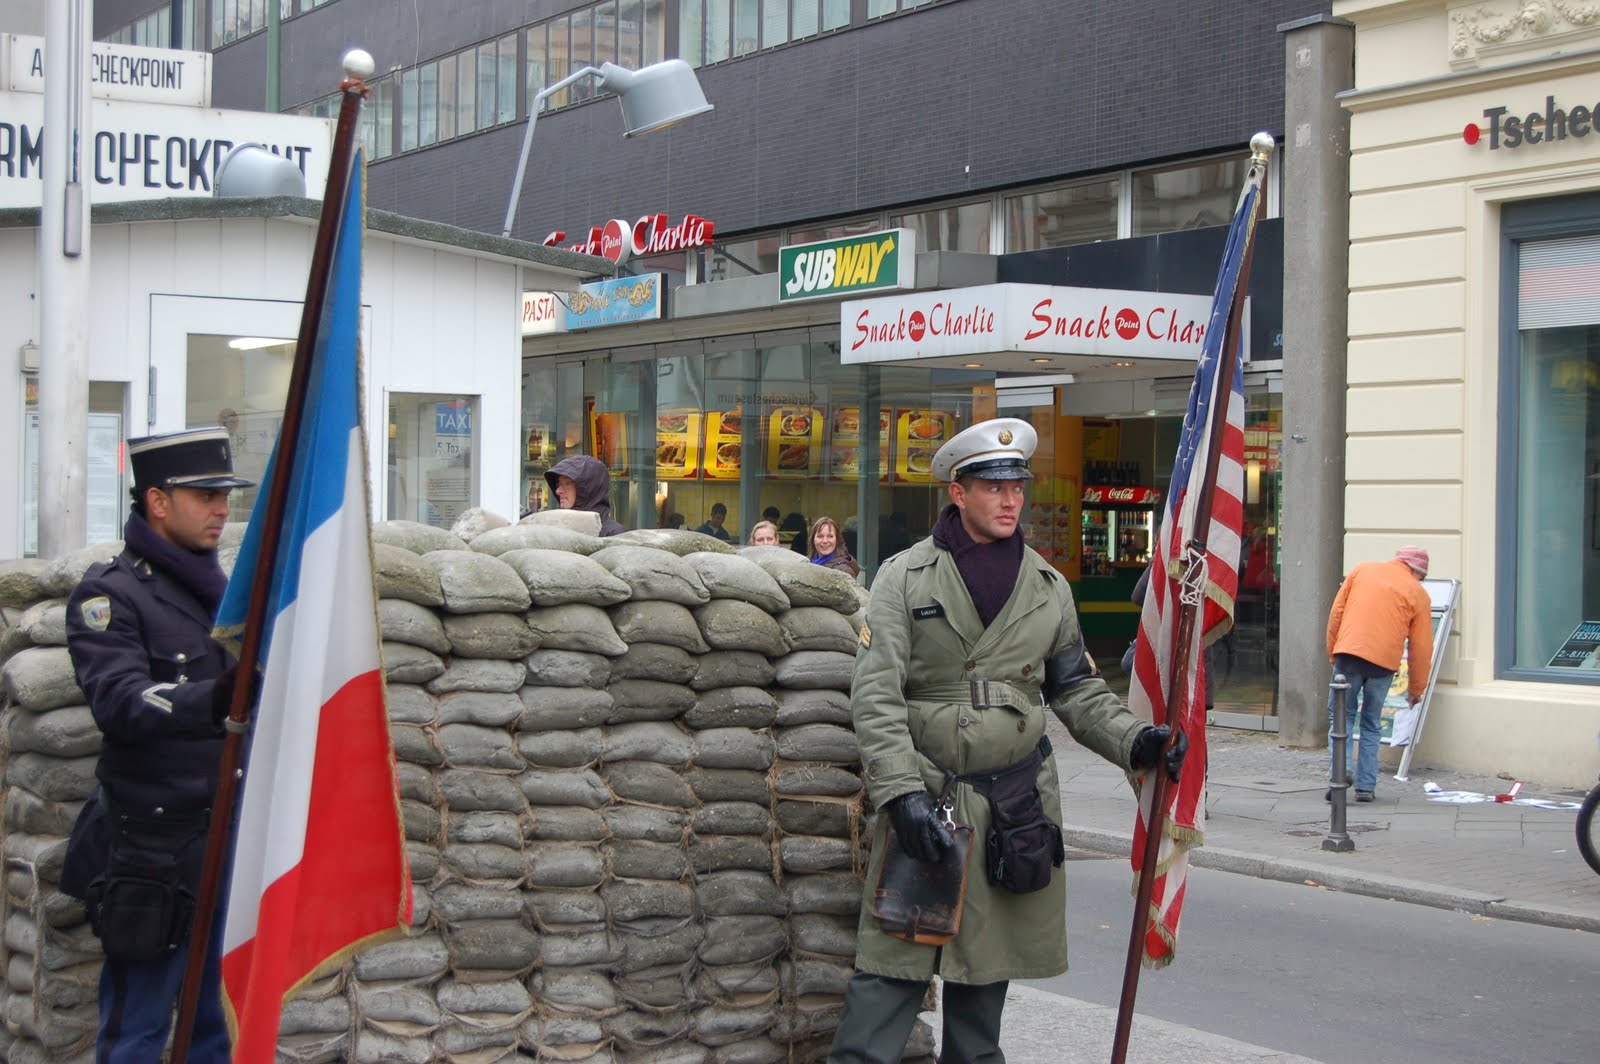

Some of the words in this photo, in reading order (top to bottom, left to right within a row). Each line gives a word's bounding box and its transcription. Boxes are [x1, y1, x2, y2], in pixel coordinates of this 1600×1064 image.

[91, 53, 185, 90] CHECKPOINT
[631, 214, 712, 256] Charlie
[785, 236, 895, 296] SUBWAY
[523, 296, 555, 322] PASTA
[851, 309, 905, 351] Snack
[909, 320, 926, 334] Point
[929, 302, 994, 336] Charlie
[1024, 299, 1110, 341] Snack
[1116, 317, 1139, 330] Point
[1146, 307, 1205, 344] Char
[437, 413, 472, 429] TAXI
